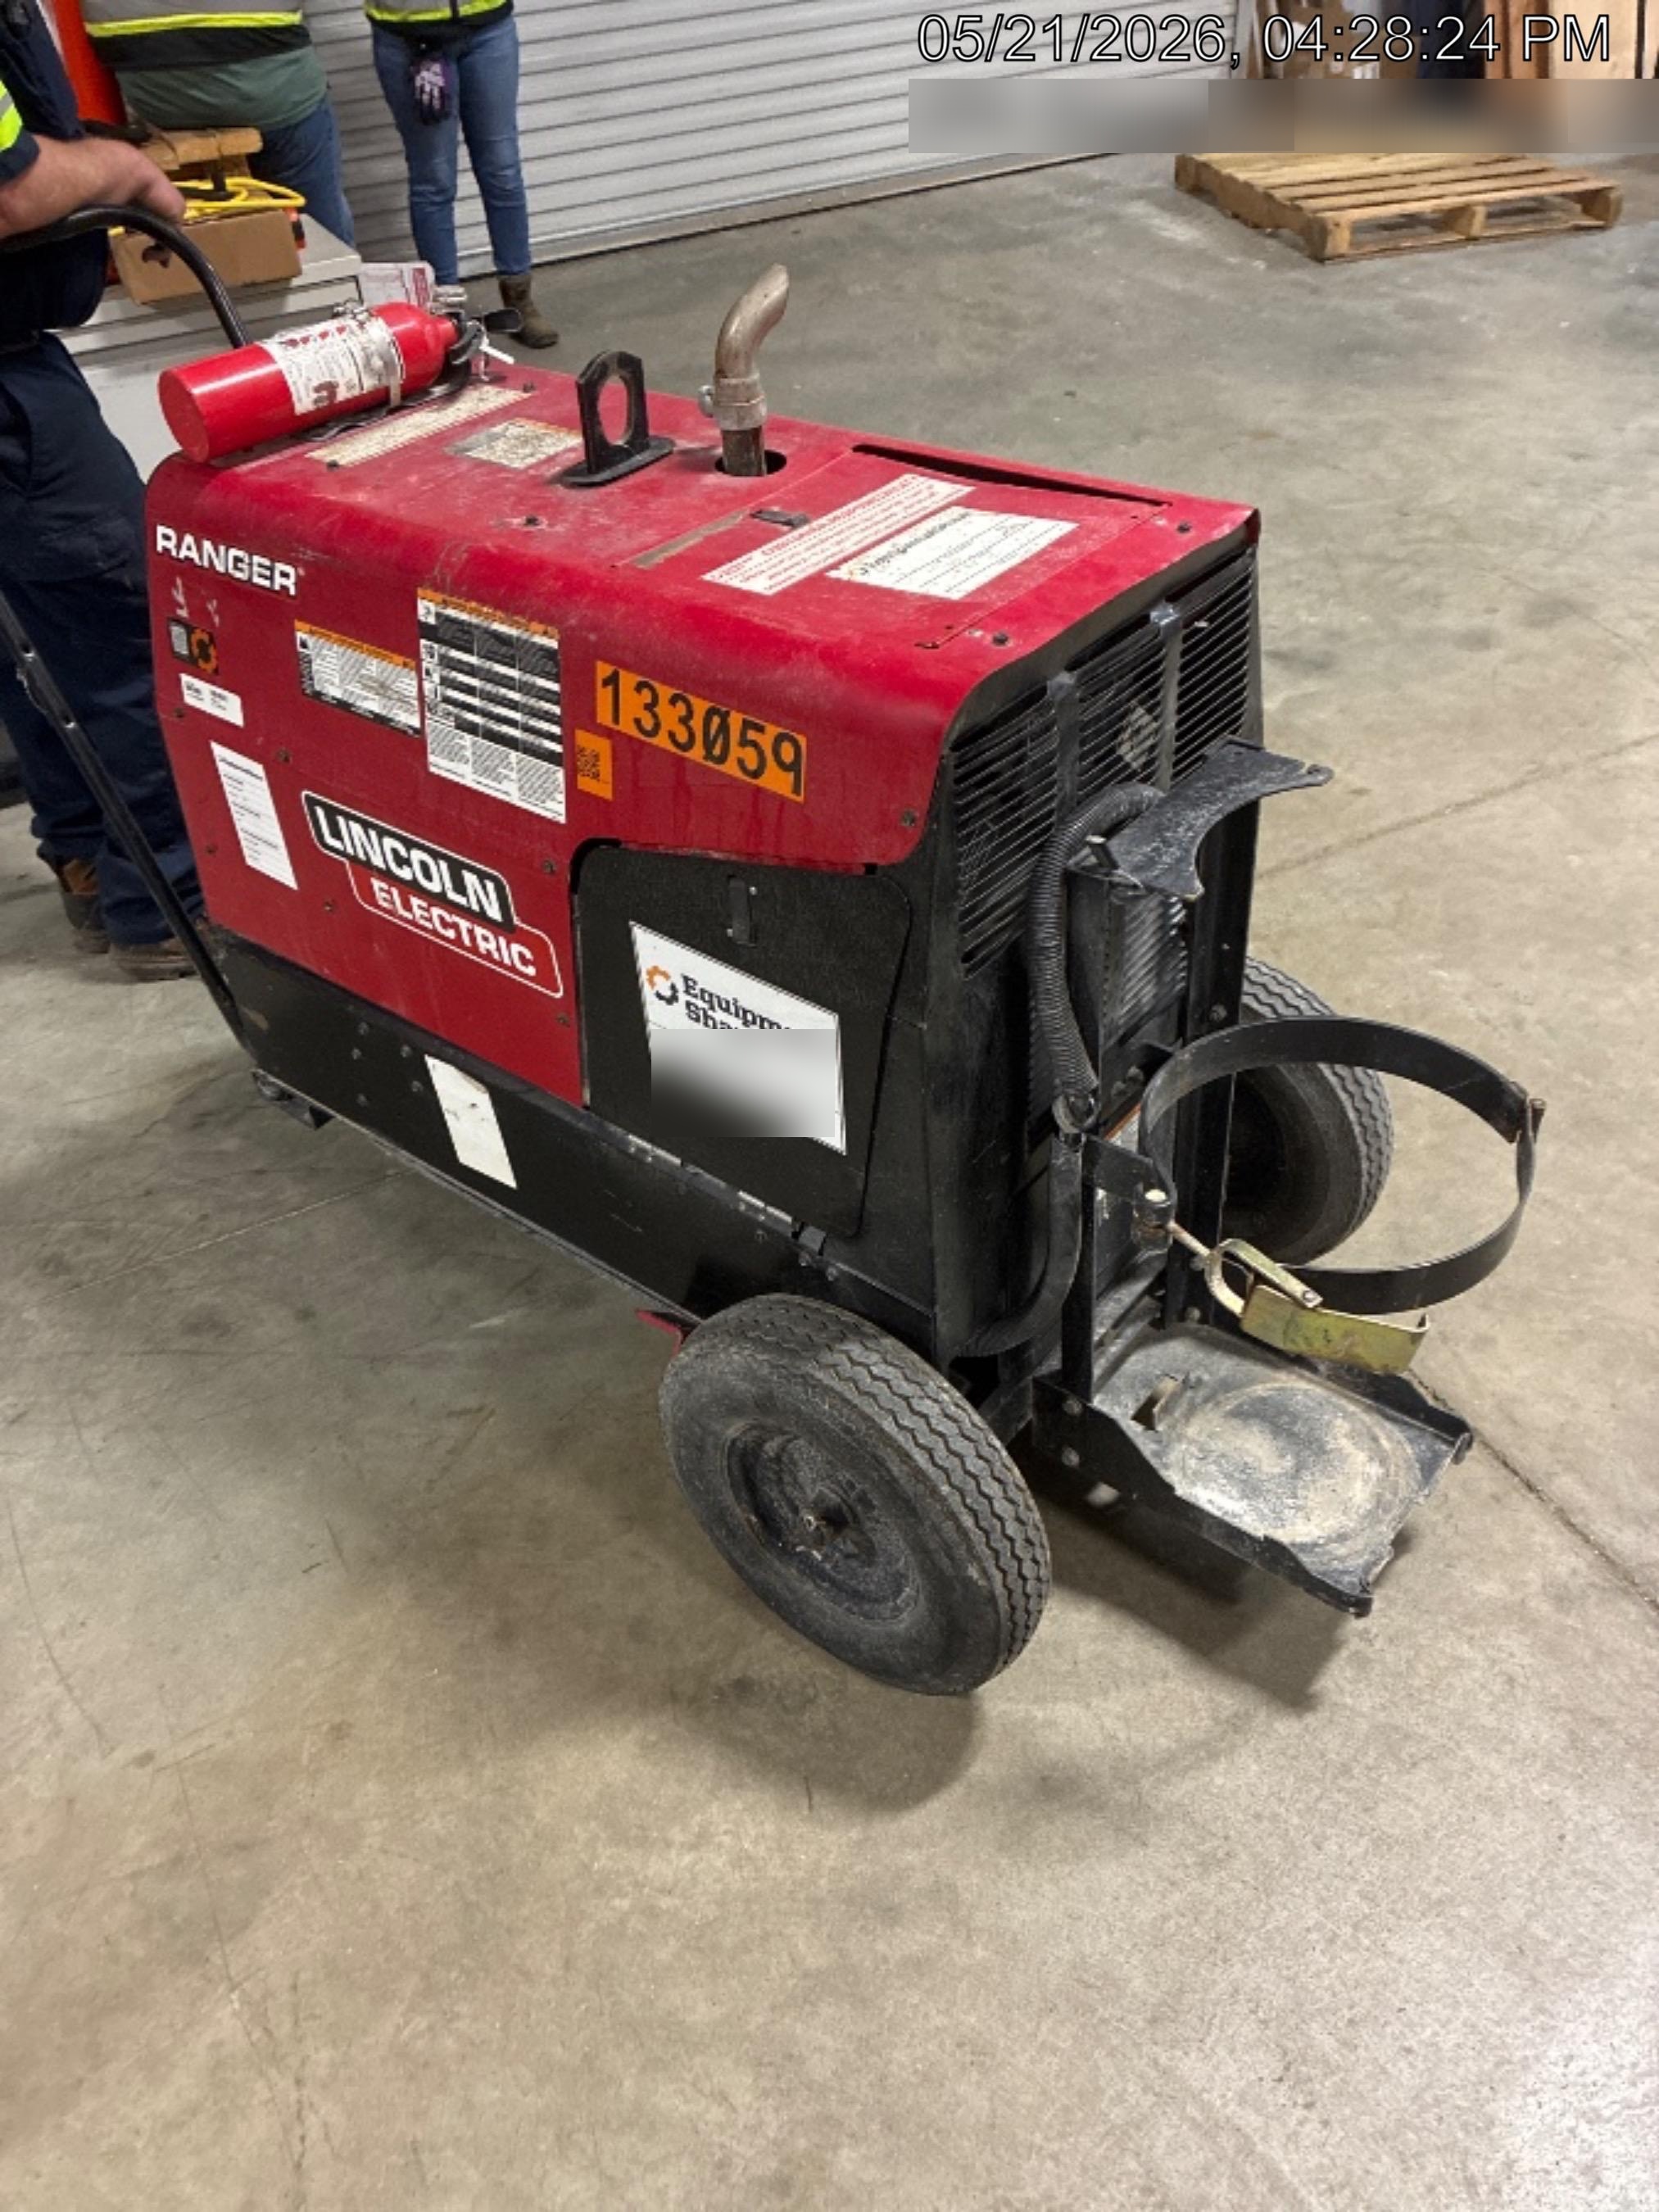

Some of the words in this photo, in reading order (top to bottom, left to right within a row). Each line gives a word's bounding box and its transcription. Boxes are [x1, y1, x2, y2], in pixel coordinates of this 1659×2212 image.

[156, 524, 297, 596] RANGER
[315, 805, 502, 922] LINCOLN
[370, 877, 537, 977] ELECTRIC
[680, 972, 791, 1030] Equipm
